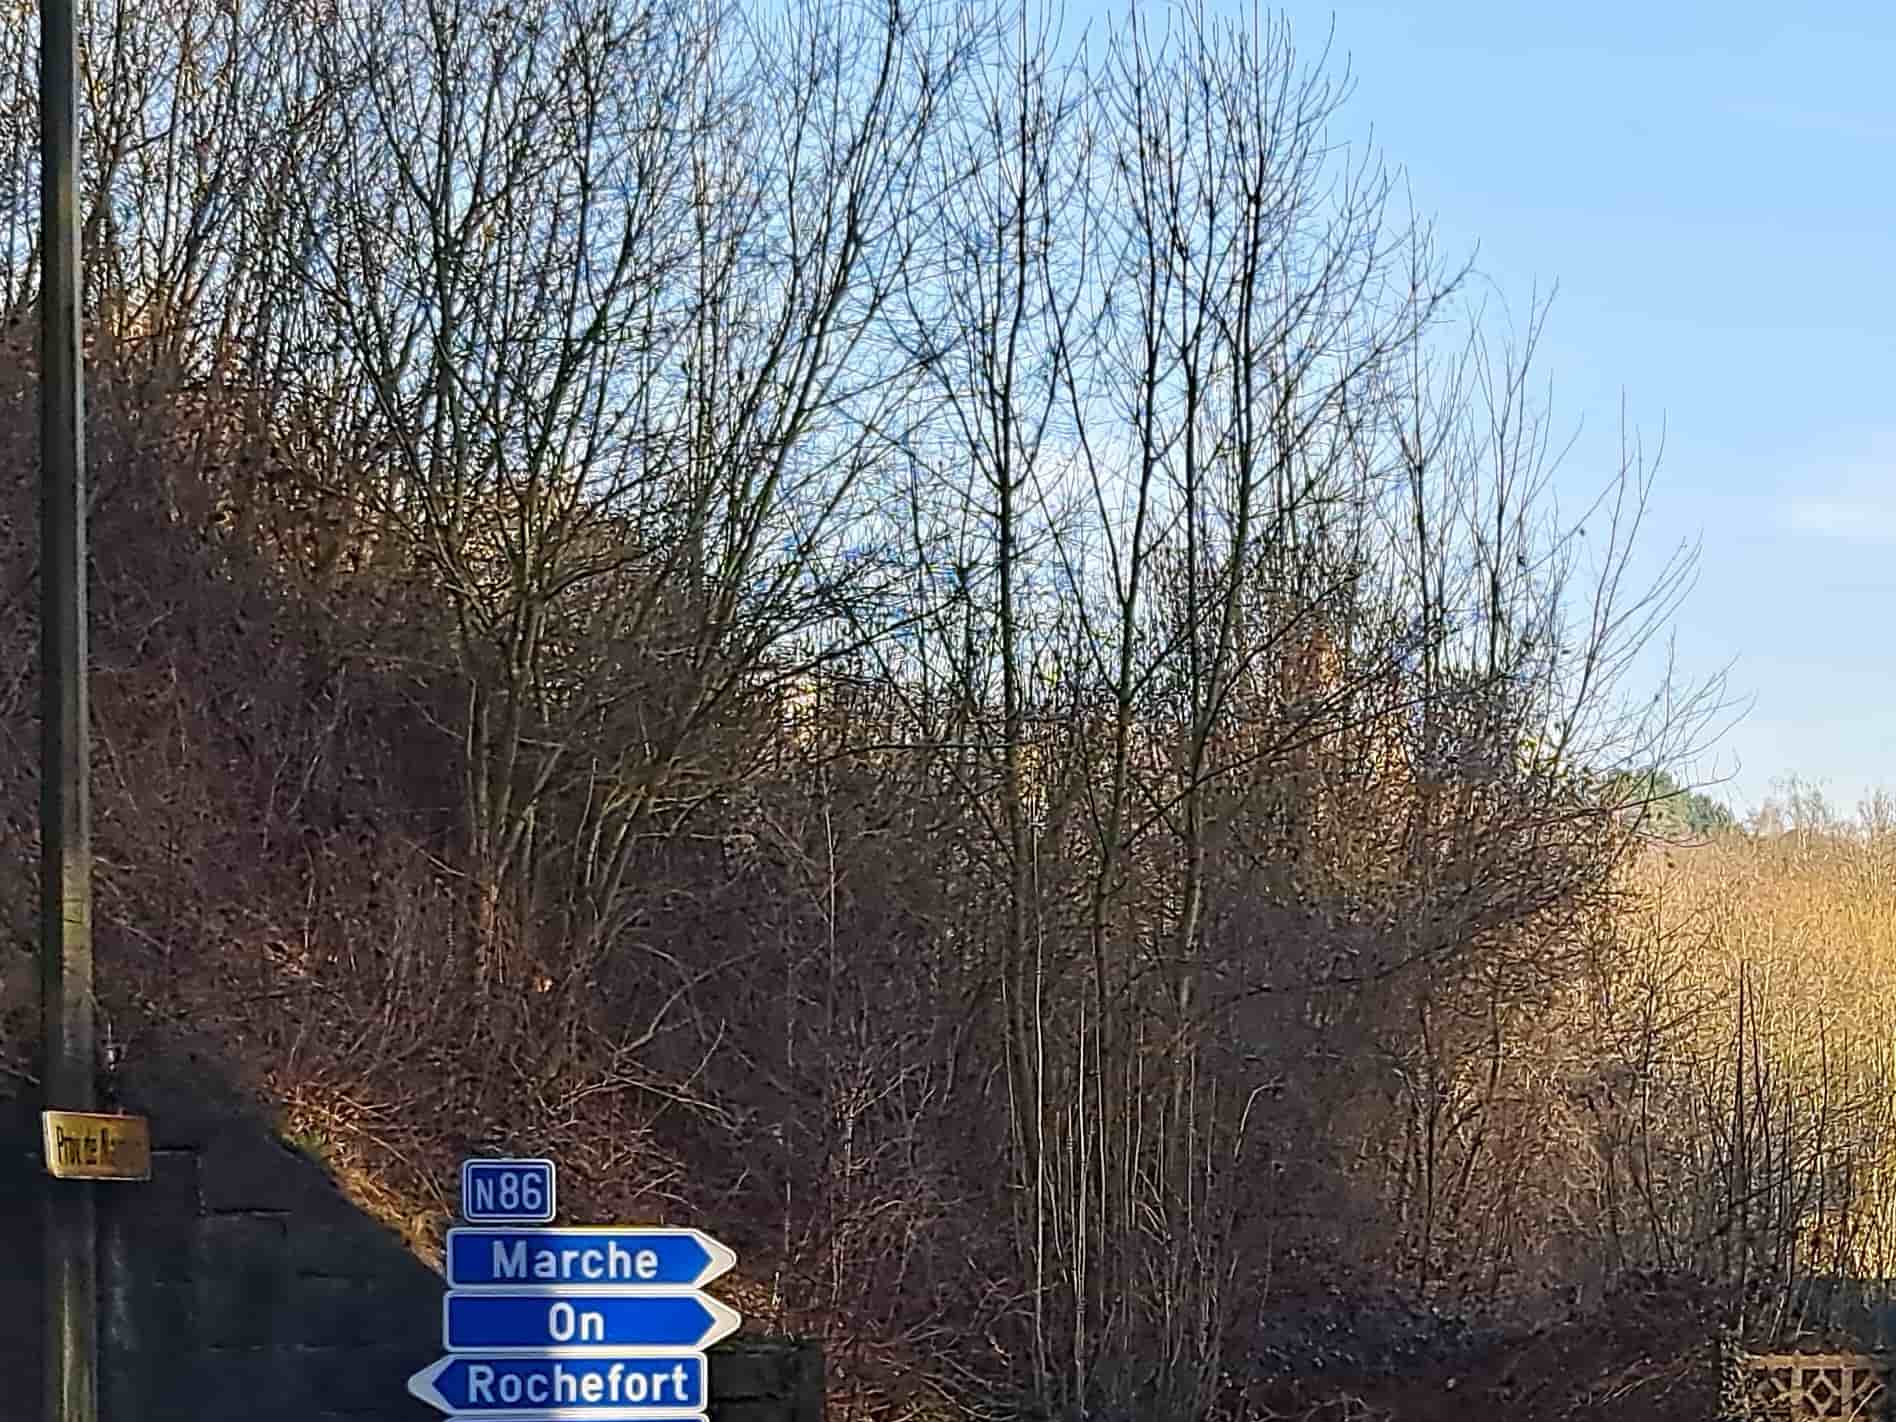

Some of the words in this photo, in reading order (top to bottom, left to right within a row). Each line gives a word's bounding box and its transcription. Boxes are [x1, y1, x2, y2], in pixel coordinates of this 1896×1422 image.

[476, 1171, 543, 1211] N86
[492, 1240, 659, 1279] Marche
[549, 1302, 605, 1341] On
[468, 1363, 689, 1402] Rochefort
